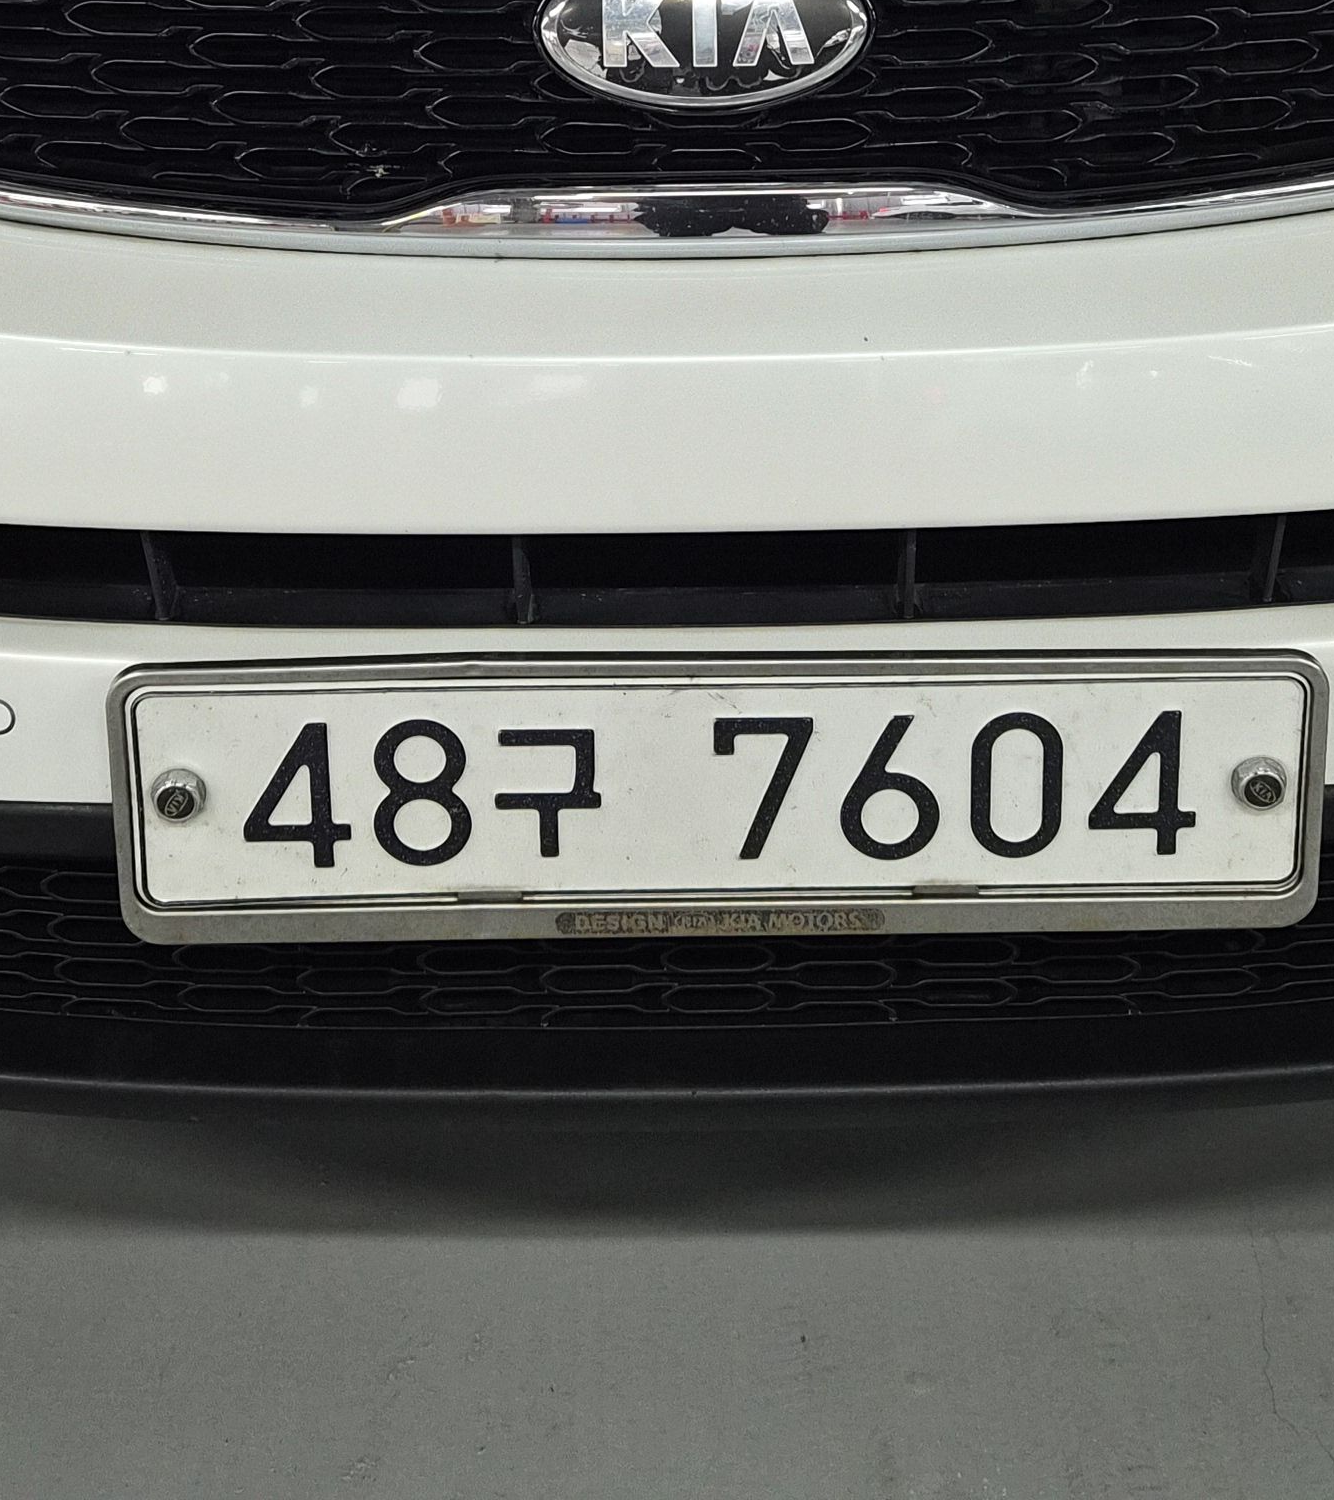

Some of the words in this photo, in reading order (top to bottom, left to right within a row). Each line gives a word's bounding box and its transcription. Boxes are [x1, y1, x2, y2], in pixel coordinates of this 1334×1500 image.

[244, 720, 602, 868] 48구
[714, 711, 1197, 860] 7604
[575, 912, 667, 933] DESIGN
[769, 910, 863, 931] MOTORS
